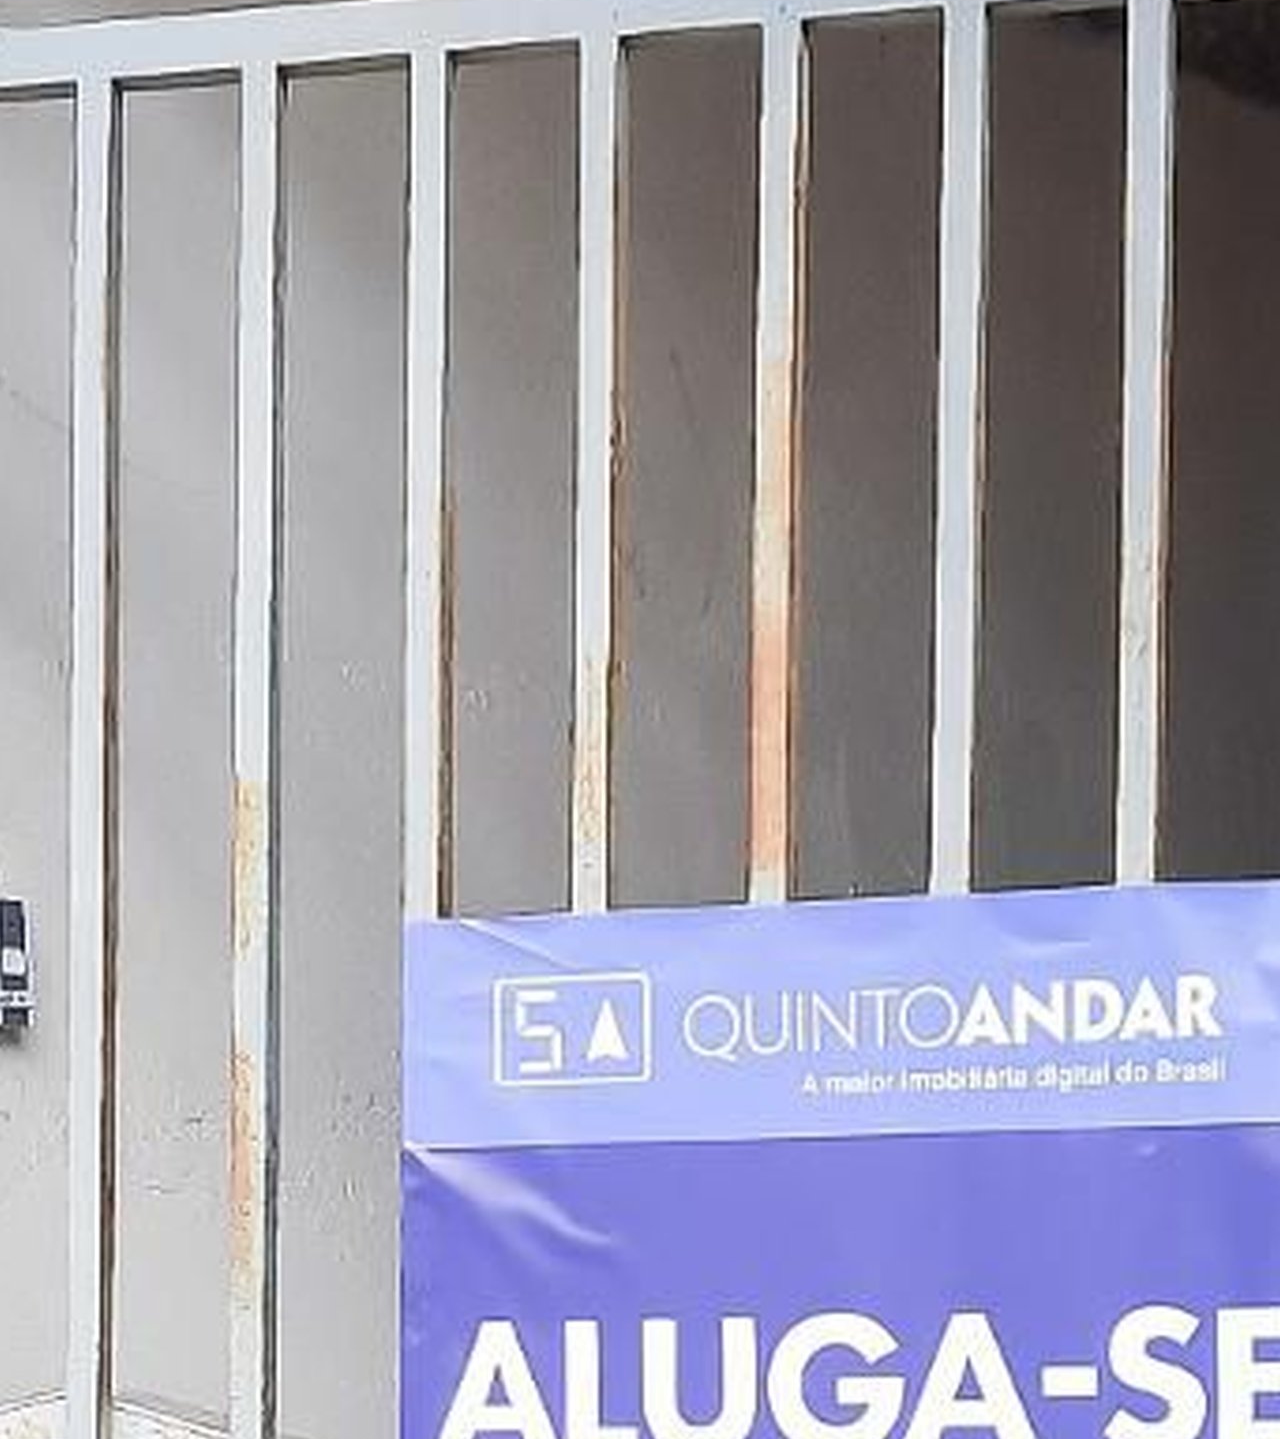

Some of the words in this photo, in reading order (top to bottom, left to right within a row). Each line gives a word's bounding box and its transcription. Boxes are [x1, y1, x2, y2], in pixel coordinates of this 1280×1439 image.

[681, 973, 1223, 1059] QUINTOANDAR
[801, 1072, 820, 1094] A
[824, 1070, 895, 1094] maior
[1034, 1057, 1111, 1094] digital
[1114, 1058, 1150, 1085] do
[1155, 1055, 1227, 1084] Brasil
